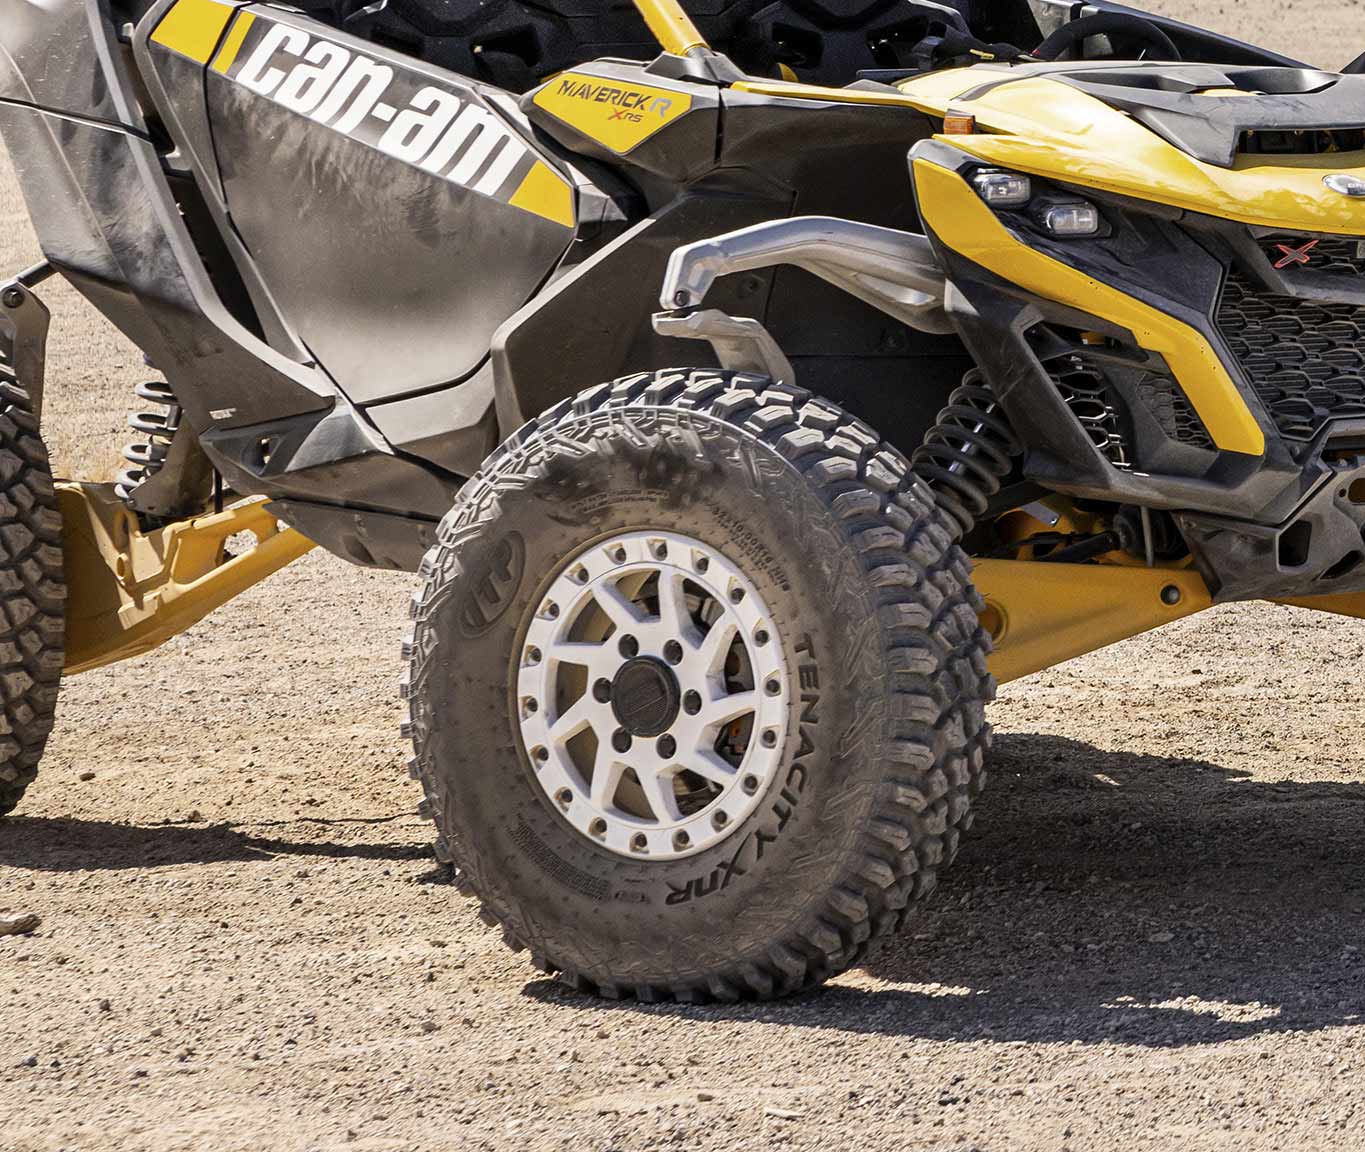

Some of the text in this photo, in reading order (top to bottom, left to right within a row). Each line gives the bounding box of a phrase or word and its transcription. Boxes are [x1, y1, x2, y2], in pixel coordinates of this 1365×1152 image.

[235, 23, 528, 197] can-am
[557, 79, 673, 118] MAVERICK R
[755, 632, 819, 861] TENACITY
